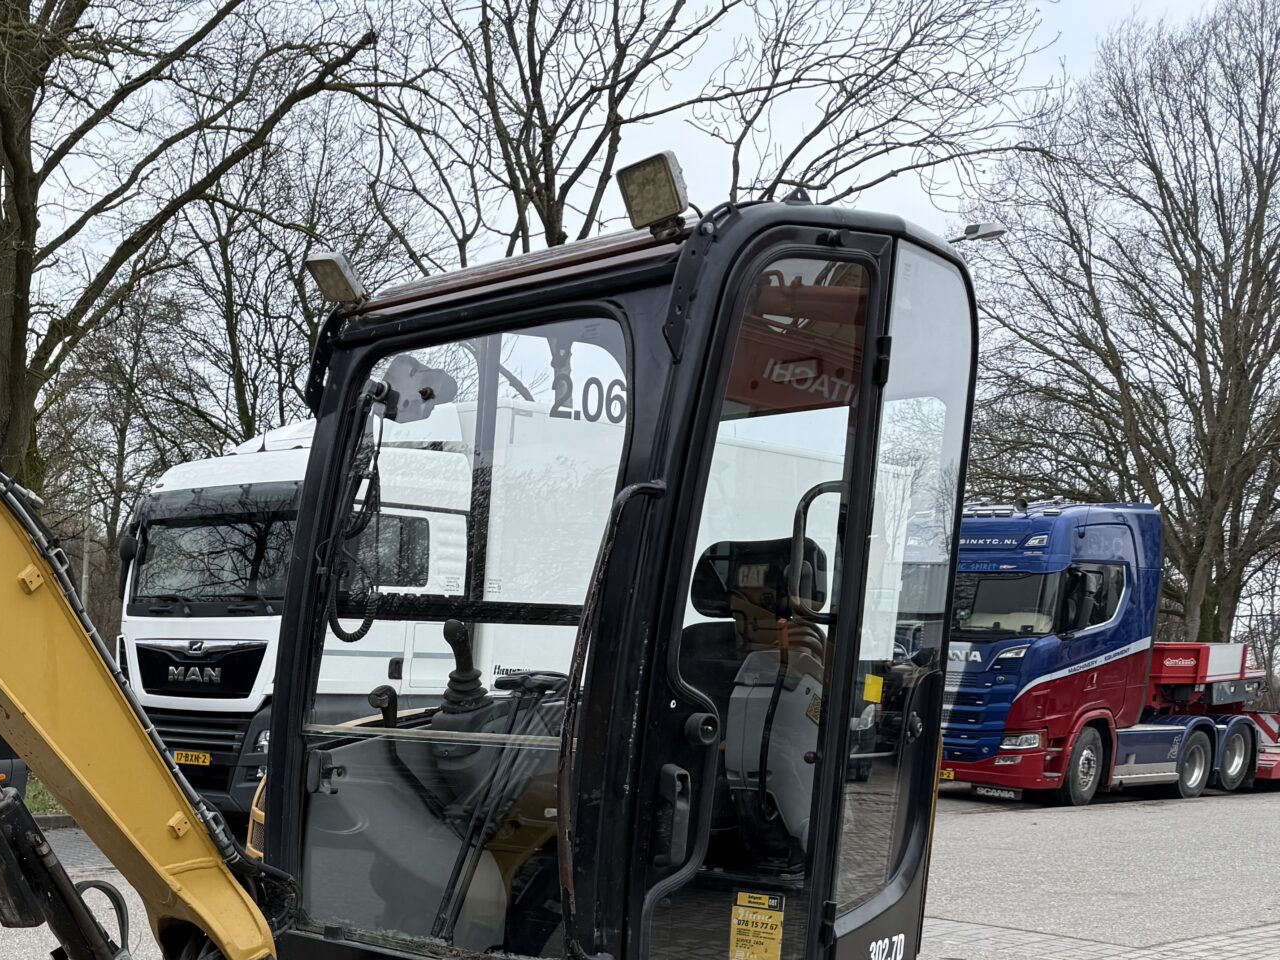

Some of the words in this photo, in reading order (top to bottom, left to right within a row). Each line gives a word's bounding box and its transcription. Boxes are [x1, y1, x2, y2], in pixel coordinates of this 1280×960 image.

[549, 373, 626, 424] 2.06
[738, 564, 770, 588] CAT
[1067, 659, 1099, 674] MACHINERY
[1104, 647, 1131, 662] EQUIPMENT
[167, 665, 222, 683] MAN
[976, 787, 1016, 799] SCANIA
